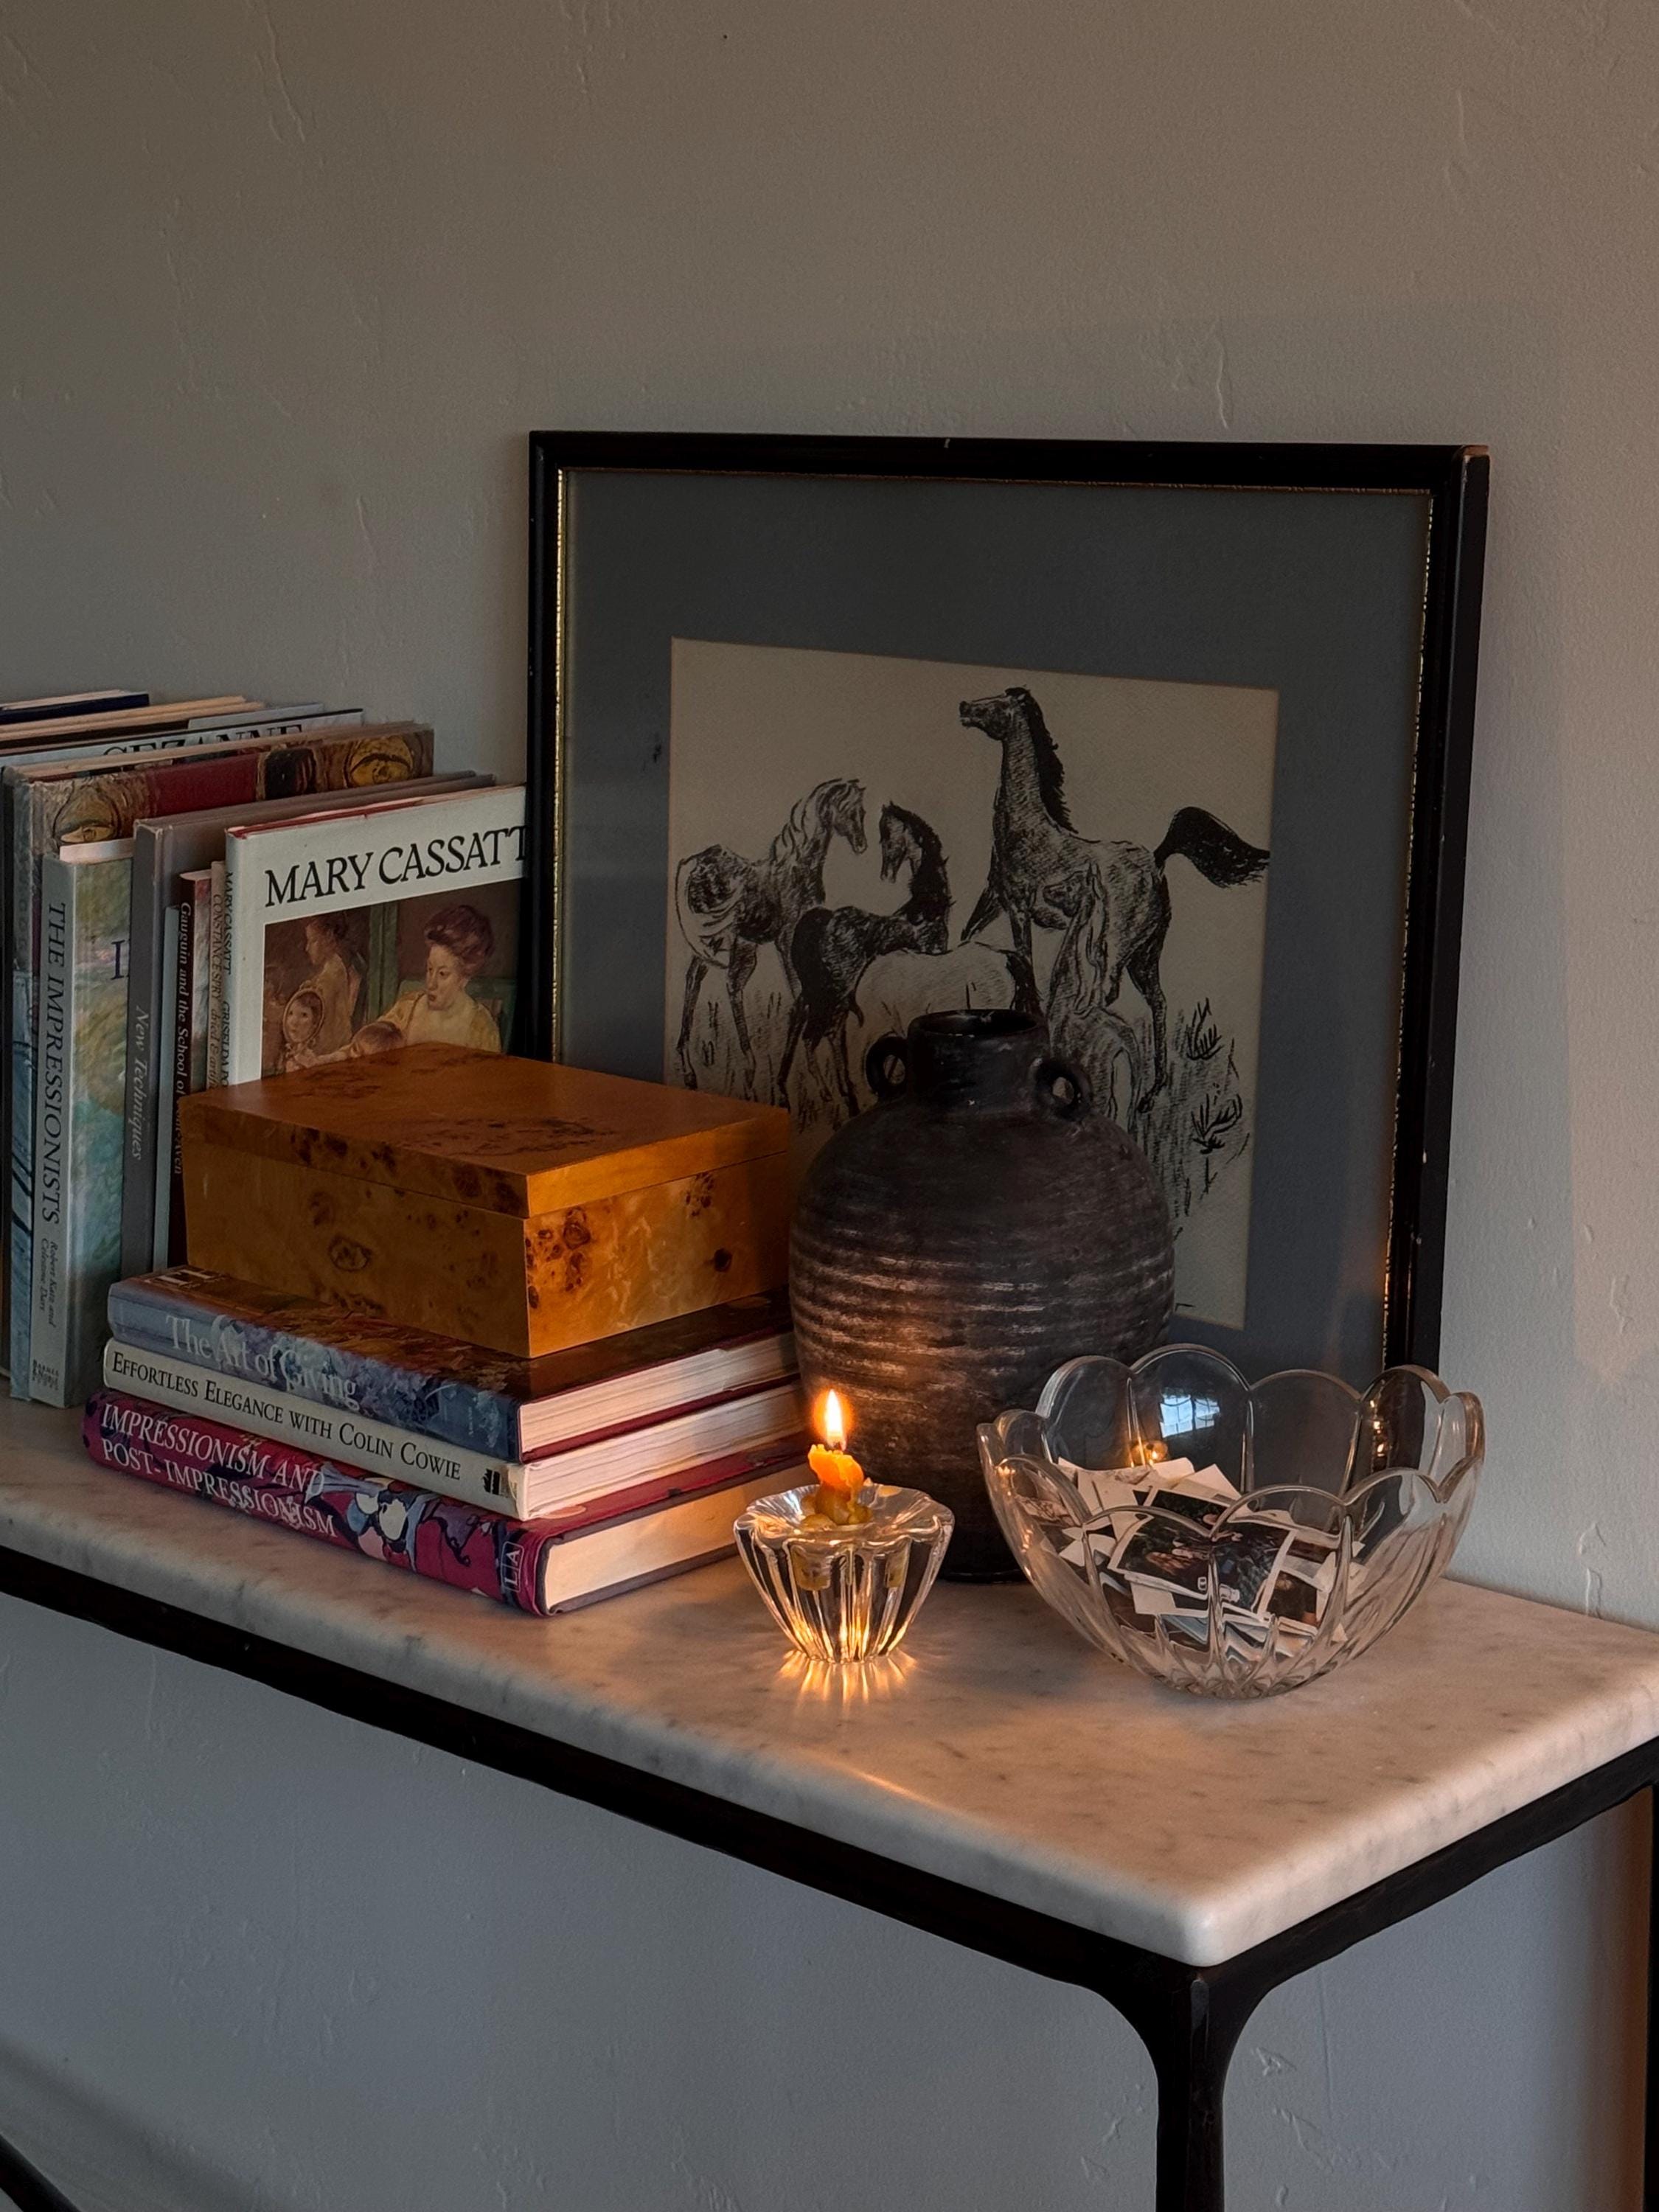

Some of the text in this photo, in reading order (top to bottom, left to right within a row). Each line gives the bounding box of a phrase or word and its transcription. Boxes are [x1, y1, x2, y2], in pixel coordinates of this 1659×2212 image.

[265, 825, 529, 907] MARY CASSATT
[178, 902, 191, 964] Gauguin
[211, 894, 222, 1001] CONSTANCE SPRY
[223, 872, 234, 975] MARY CASSATT
[178, 968, 189, 995] and
[178, 999, 189, 1023] the
[42, 902, 66, 1224] THE IMPRESSIONISTS
[128, 1005, 149, 1161] New Techniques
[176, 1026, 188, 1076] School
[165, 1314, 361, 1411] The Art of Giving
[100, 1402, 324, 1496] IMPRESSIONISM AND
[112, 1351, 199, 1398] EFFORTLESS
[204, 1379, 284, 1424] ELEGANCE
[338, 1422, 394, 1459] COLIN
[400, 1441, 462, 1481] COWIE
